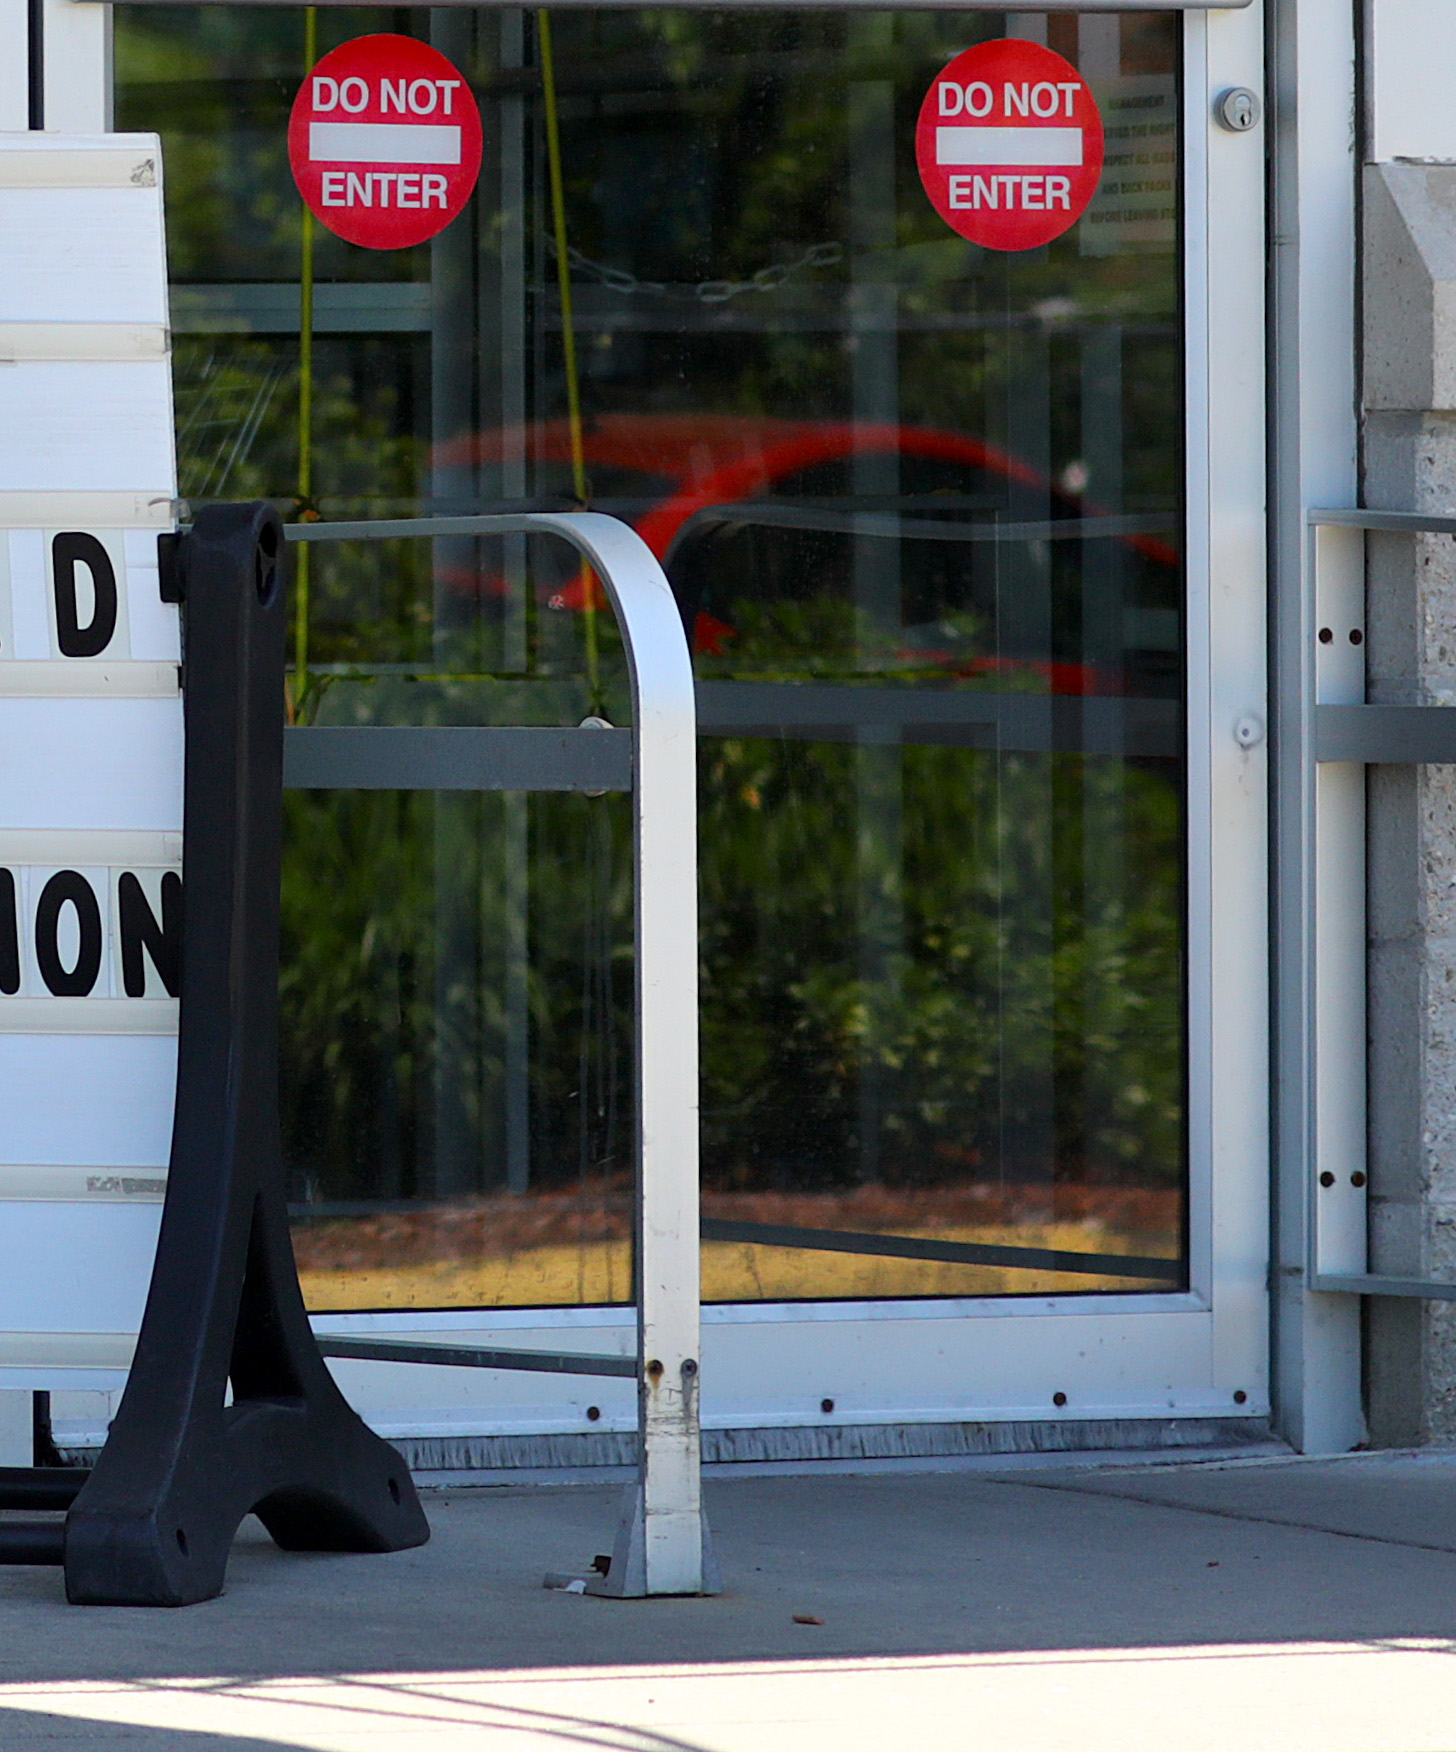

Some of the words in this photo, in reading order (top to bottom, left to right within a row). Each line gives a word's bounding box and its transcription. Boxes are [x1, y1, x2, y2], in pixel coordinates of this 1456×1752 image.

[311, 76, 369, 114] DO
[378, 78, 461, 116] NOT
[937, 81, 994, 118] DO
[1002, 81, 1082, 118] NOT
[320, 171, 449, 210] ENTER
[947, 174, 1072, 211] ENTER
